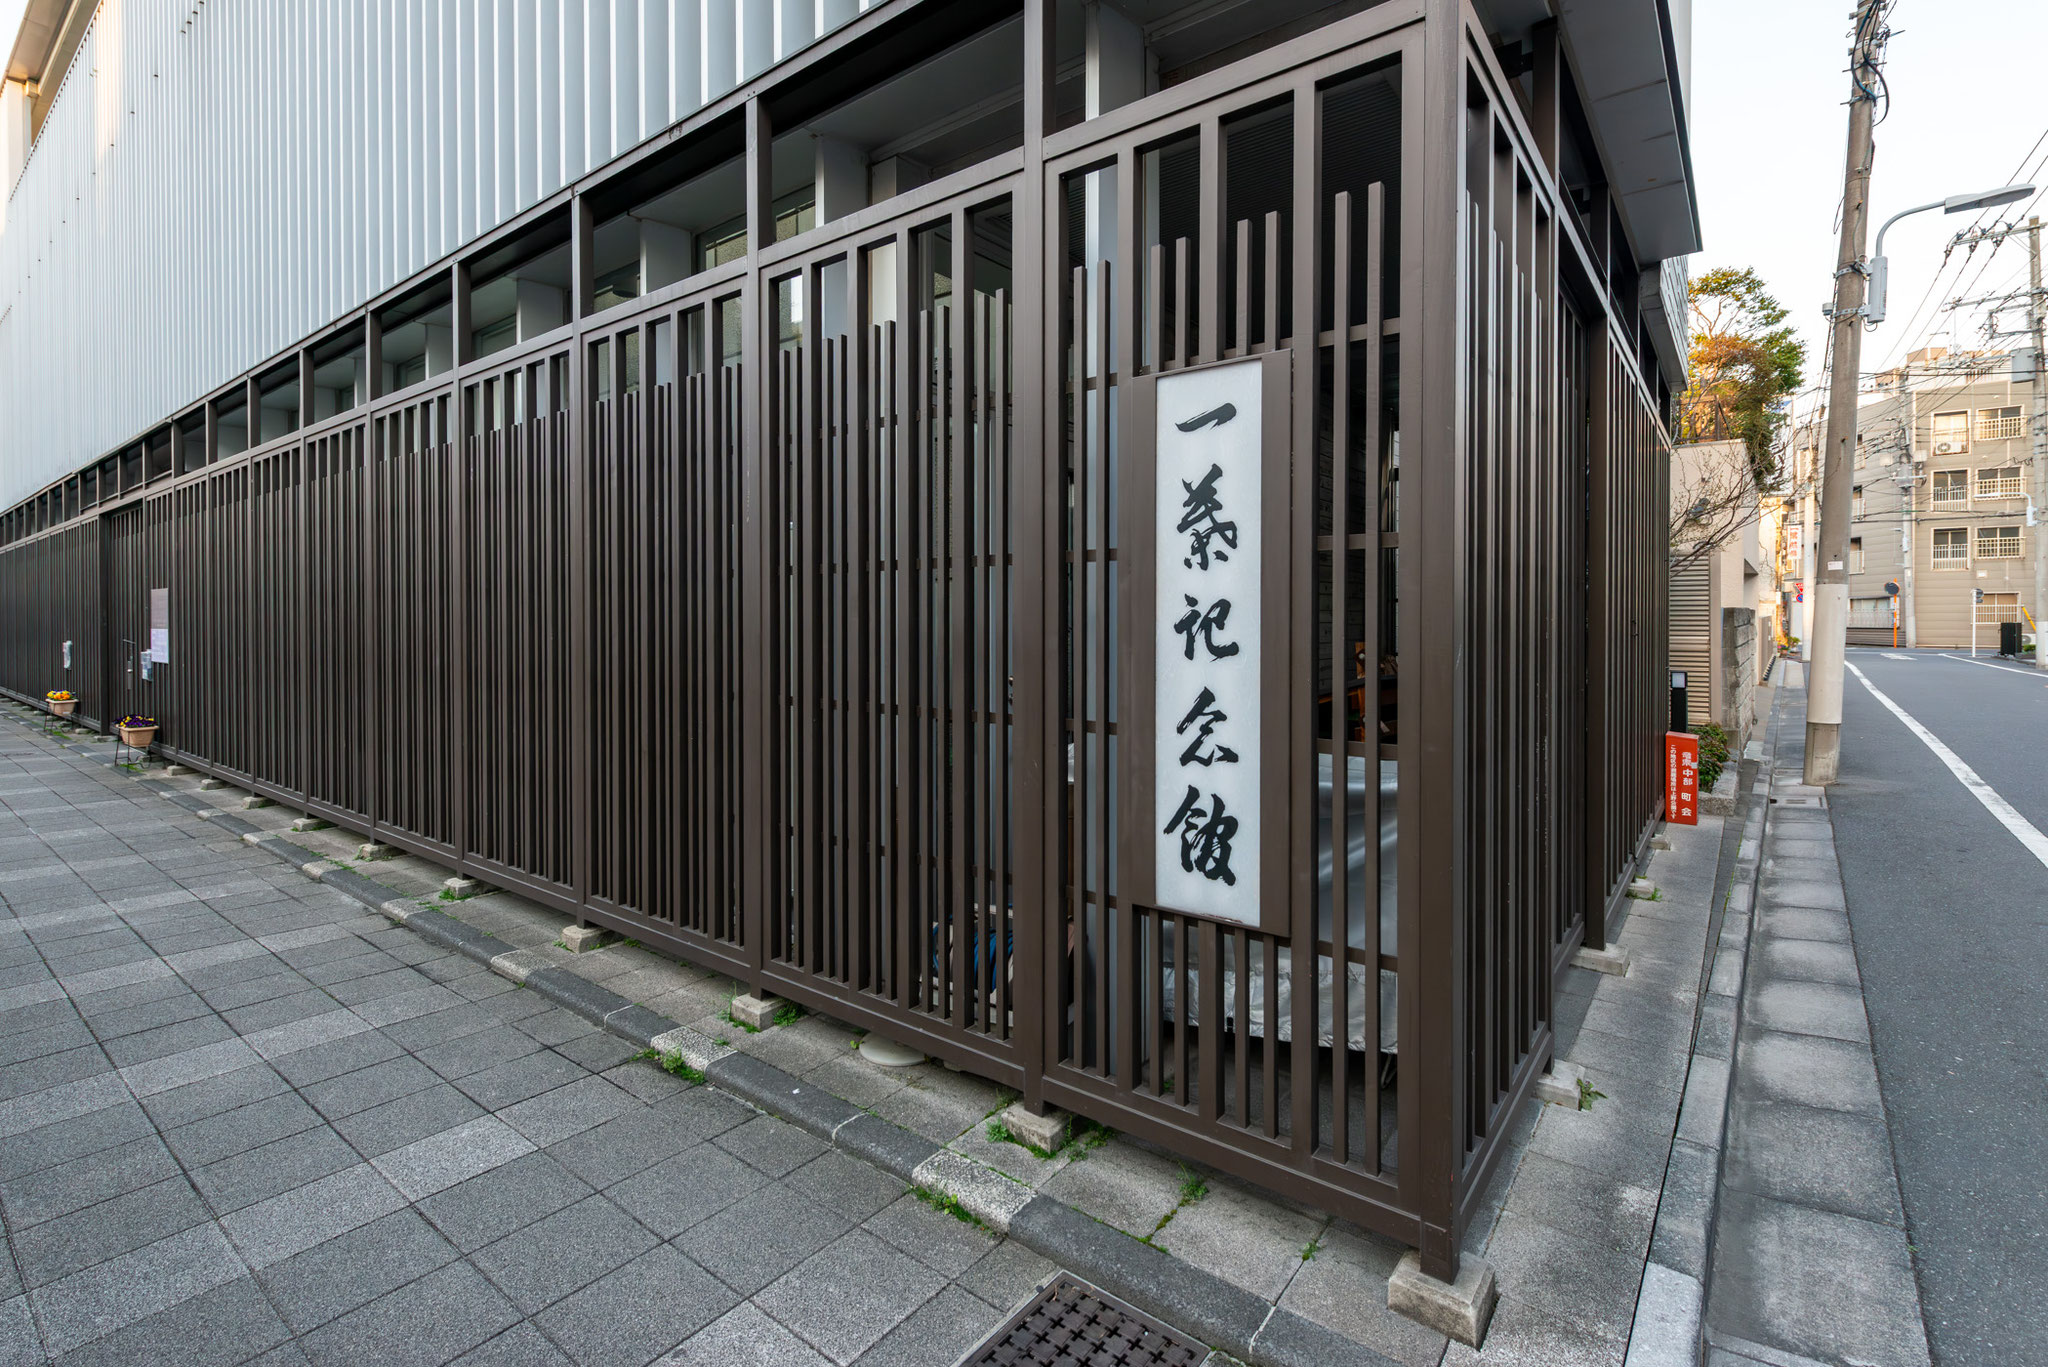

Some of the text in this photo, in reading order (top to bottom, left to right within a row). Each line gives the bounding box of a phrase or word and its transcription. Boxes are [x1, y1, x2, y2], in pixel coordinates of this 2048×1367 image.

[1164, 402, 1240, 886] 一葉記念館
